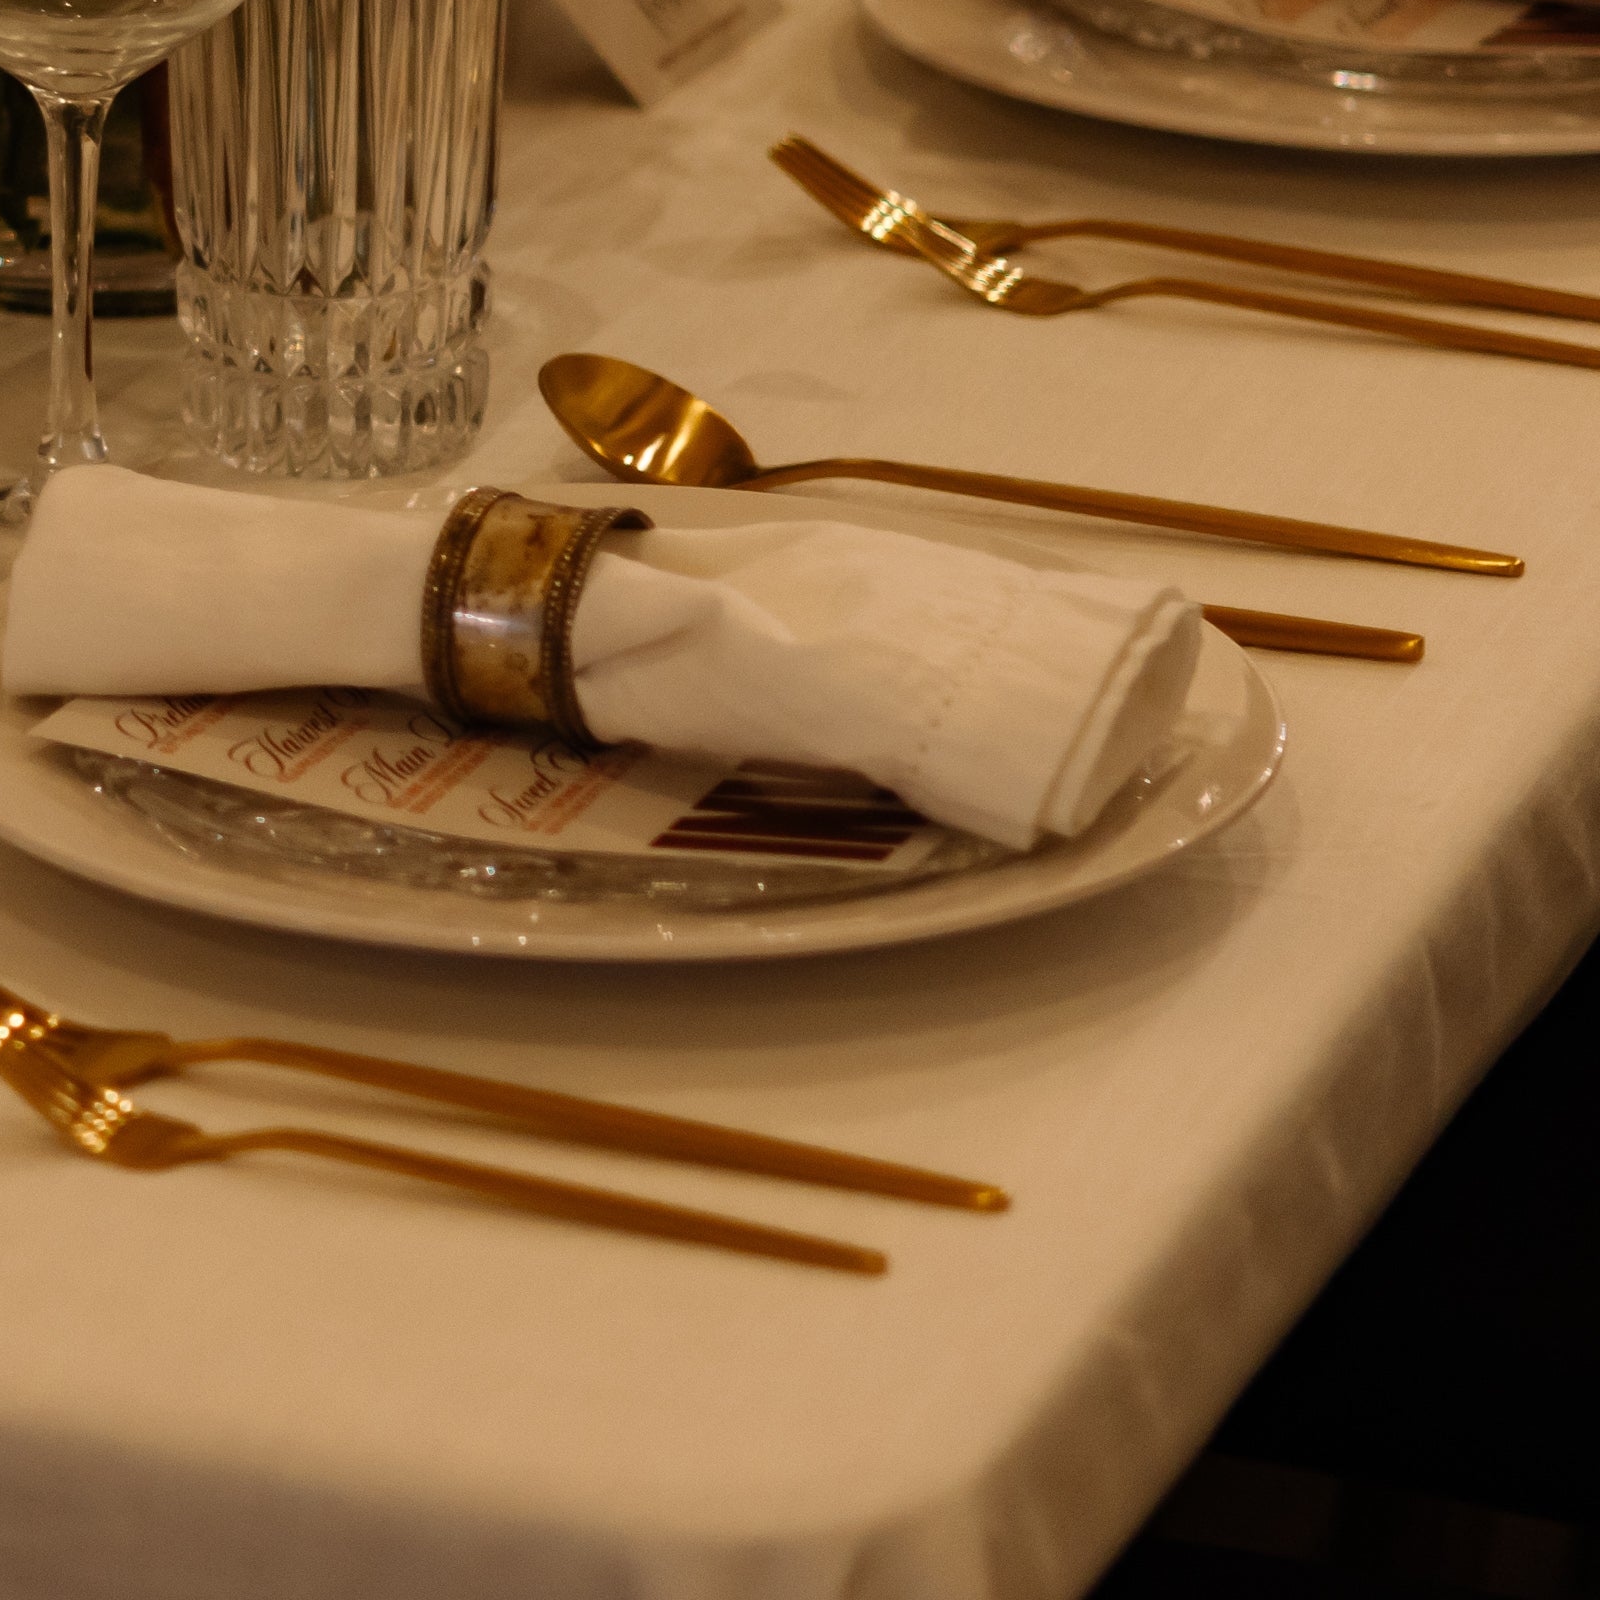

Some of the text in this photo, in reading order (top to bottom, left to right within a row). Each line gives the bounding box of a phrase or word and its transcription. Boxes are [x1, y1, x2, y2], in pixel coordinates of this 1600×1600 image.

[227, 703, 341, 779] Harvest
[341, 747, 434, 804] Main
[478, 767, 561, 828] Sweet
